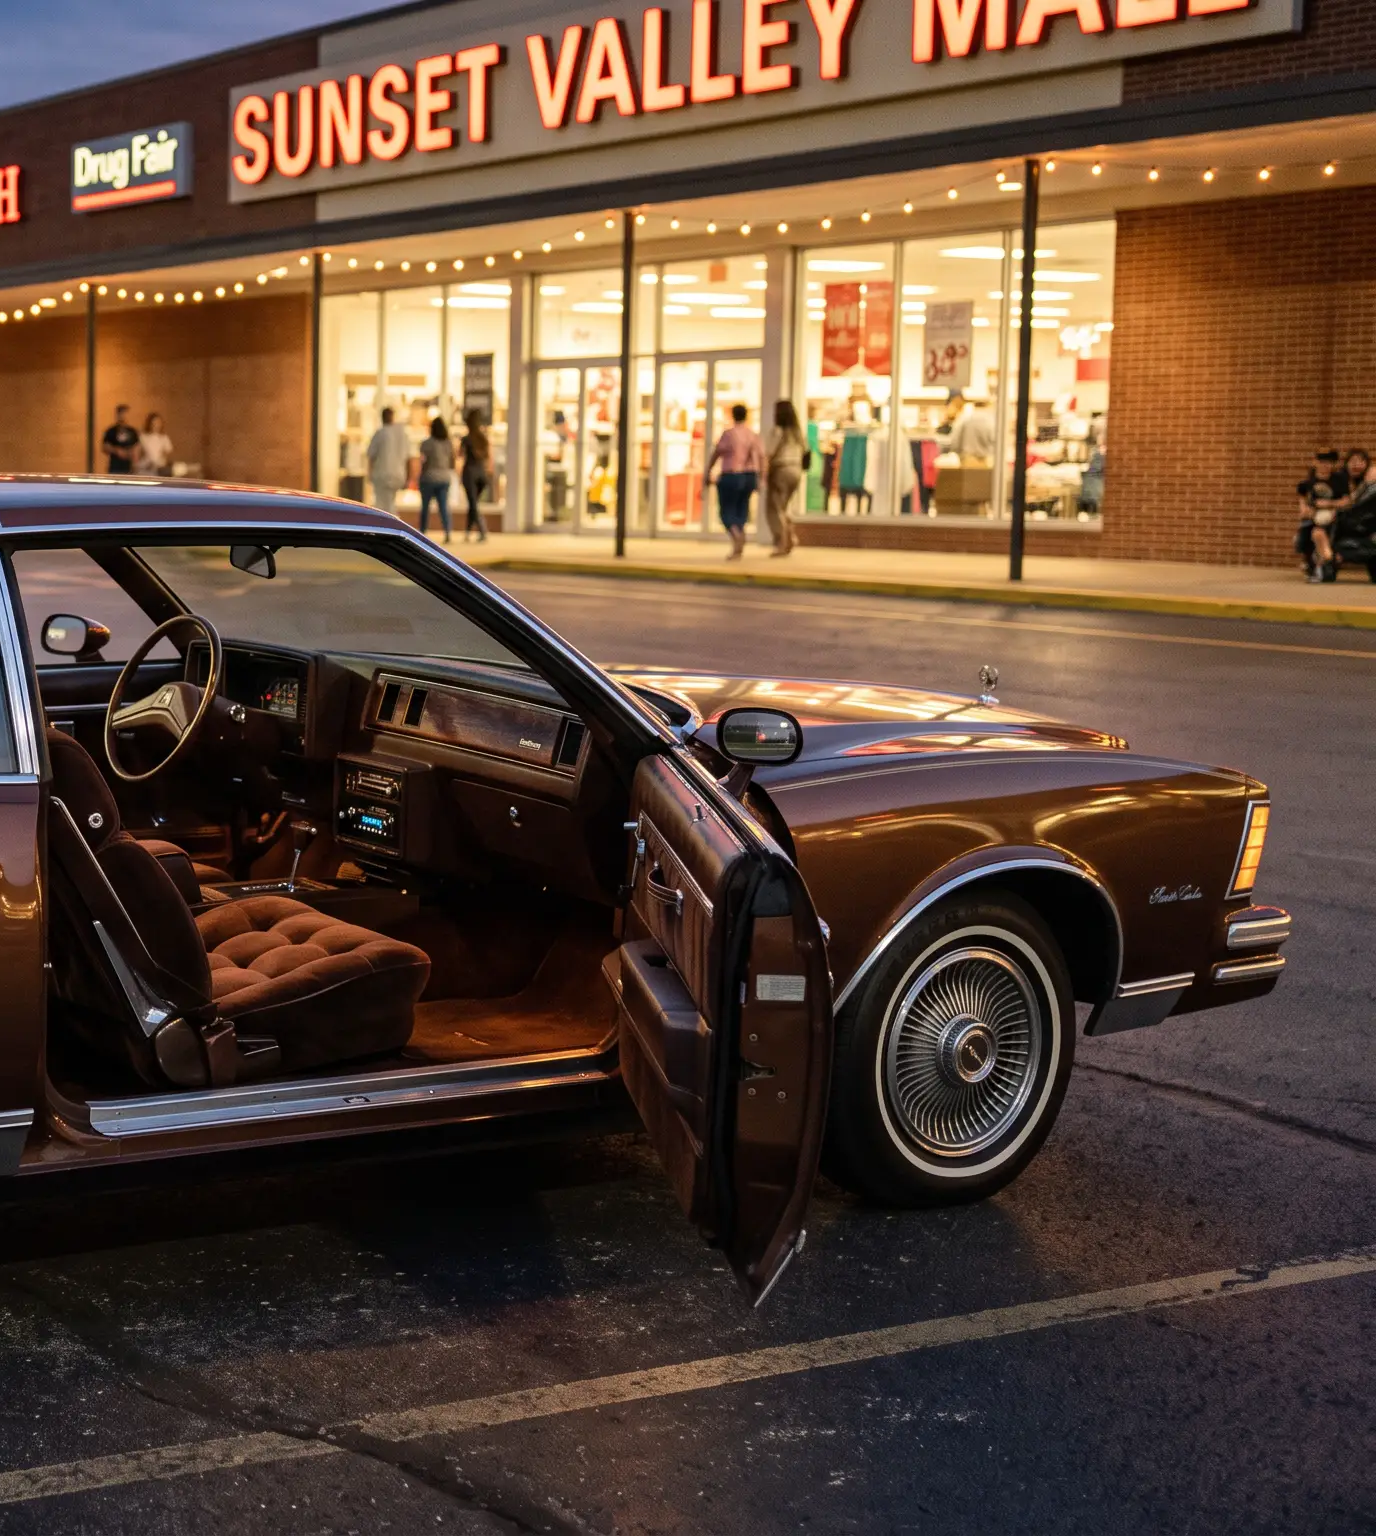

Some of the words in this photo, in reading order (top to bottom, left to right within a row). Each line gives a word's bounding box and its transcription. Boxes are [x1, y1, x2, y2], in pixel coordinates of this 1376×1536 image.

[231, 41, 501, 185] SUNSET
[524, 0, 857, 130] VALLEY
[911, 0, 1249, 64] MA
[74, 146, 129, 190] Drug
[131, 129, 178, 177] Fair
